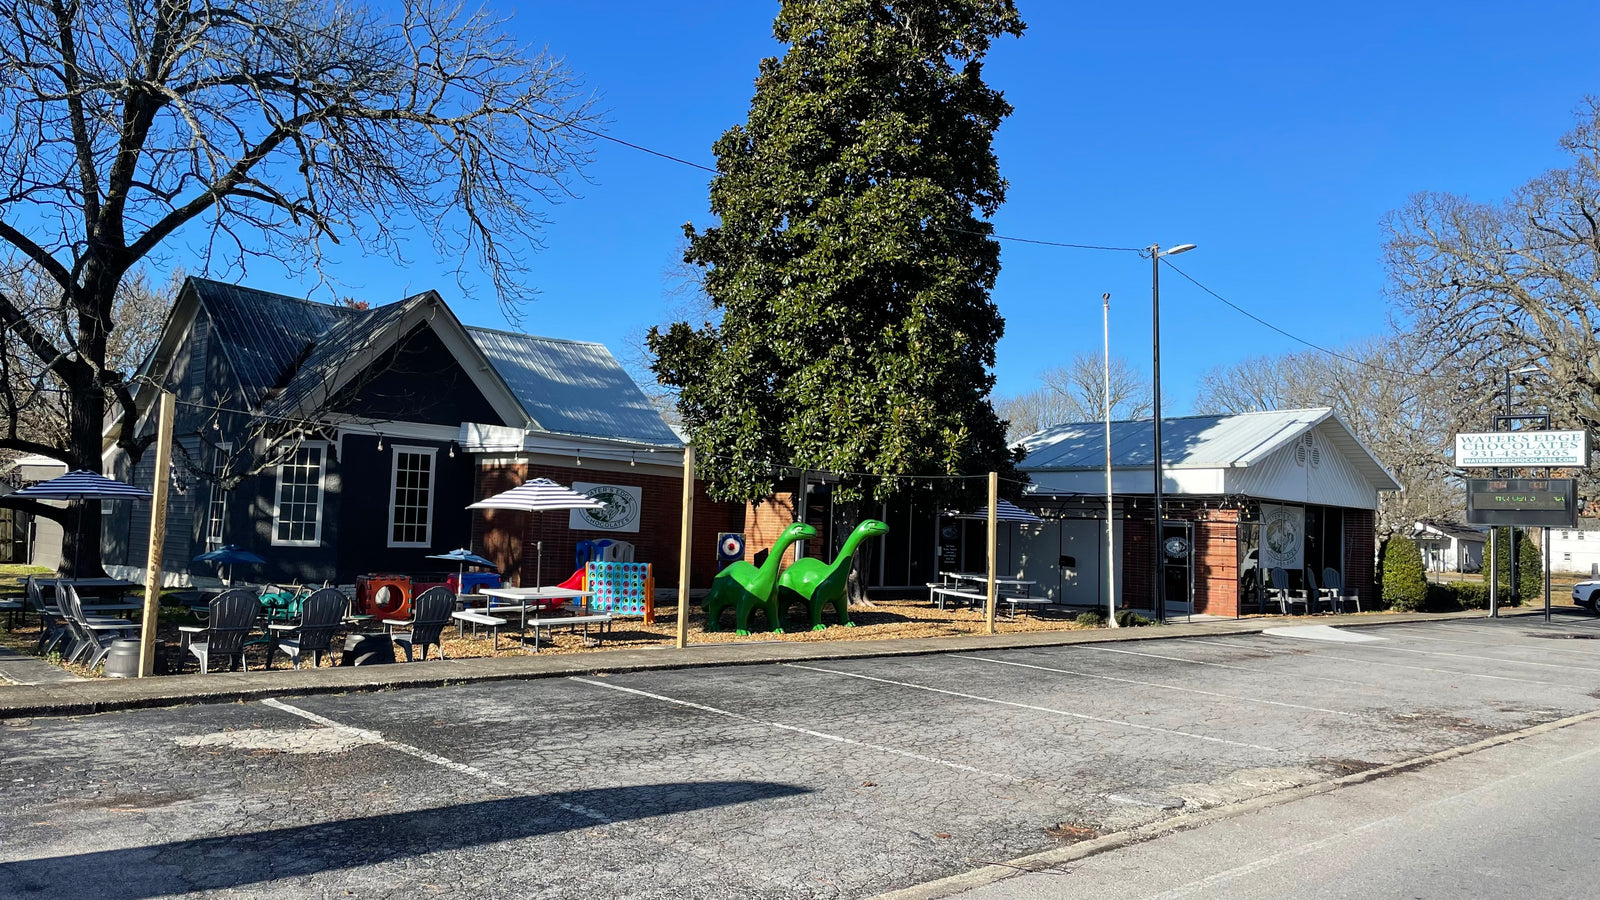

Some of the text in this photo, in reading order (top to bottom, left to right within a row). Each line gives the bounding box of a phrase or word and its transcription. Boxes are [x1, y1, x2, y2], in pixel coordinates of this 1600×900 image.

[1461, 433, 1582, 444] WATER'S EDGE
[1462, 442, 1578, 451] CHOCOLATES
[1470, 449, 1569, 457] 931-455-9365
[585, 515, 630, 528] CHOCOLATES
